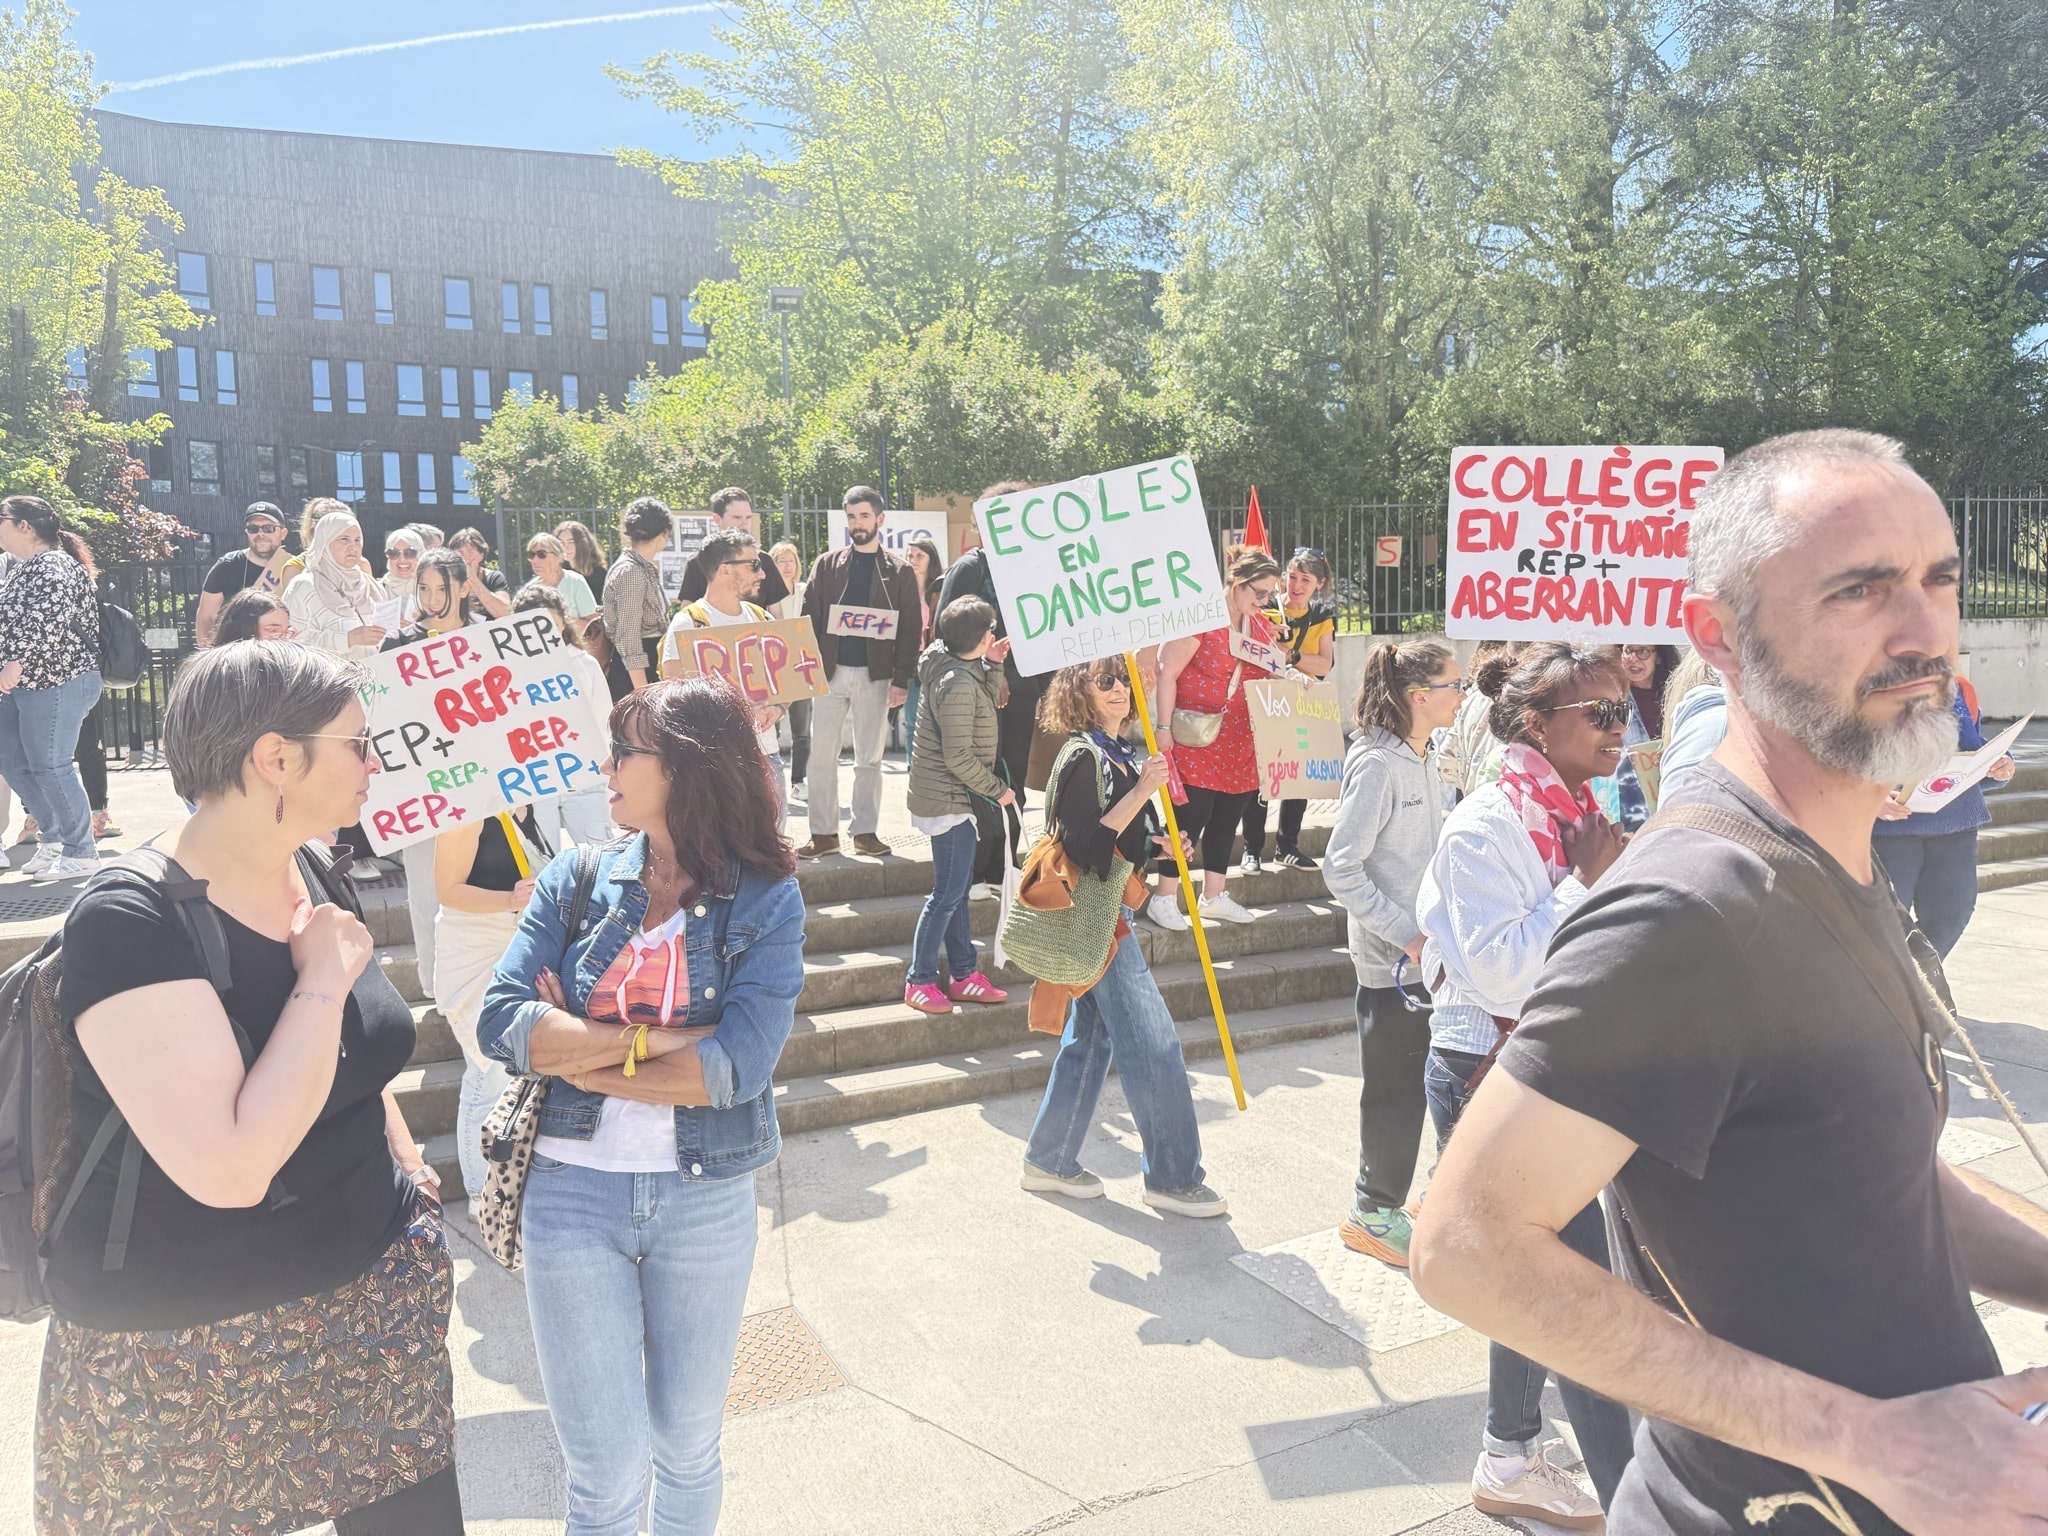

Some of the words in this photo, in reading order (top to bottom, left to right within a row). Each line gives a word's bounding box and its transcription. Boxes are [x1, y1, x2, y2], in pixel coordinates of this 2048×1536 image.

[1454, 445, 1719, 510] COLLÈGE
[985, 459, 1192, 555] ÉCOLES
[1456, 508, 1519, 552] EN
[1058, 534, 1100, 573] EN
[1378, 537, 1398, 564] S
[1016, 550, 1203, 640] DANGER
[1128, 593, 1225, 644] DEMANDÉE
[1451, 571, 1690, 629] ABERRANTE
[489, 615, 561, 660] REP+
[838, 611, 894, 635] REP+
[396, 636, 482, 687] REP+
[692, 631, 820, 702] REP+
[434, 665, 522, 734] REP+
[525, 674, 580, 706] REP+
[1255, 683, 1291, 717] Vos
[371, 721, 454, 773] EP+
[507, 716, 579, 764] REP+
[427, 761, 489, 793] REP+
[497, 752, 601, 804] REP+
[372, 794, 466, 841] REP+
